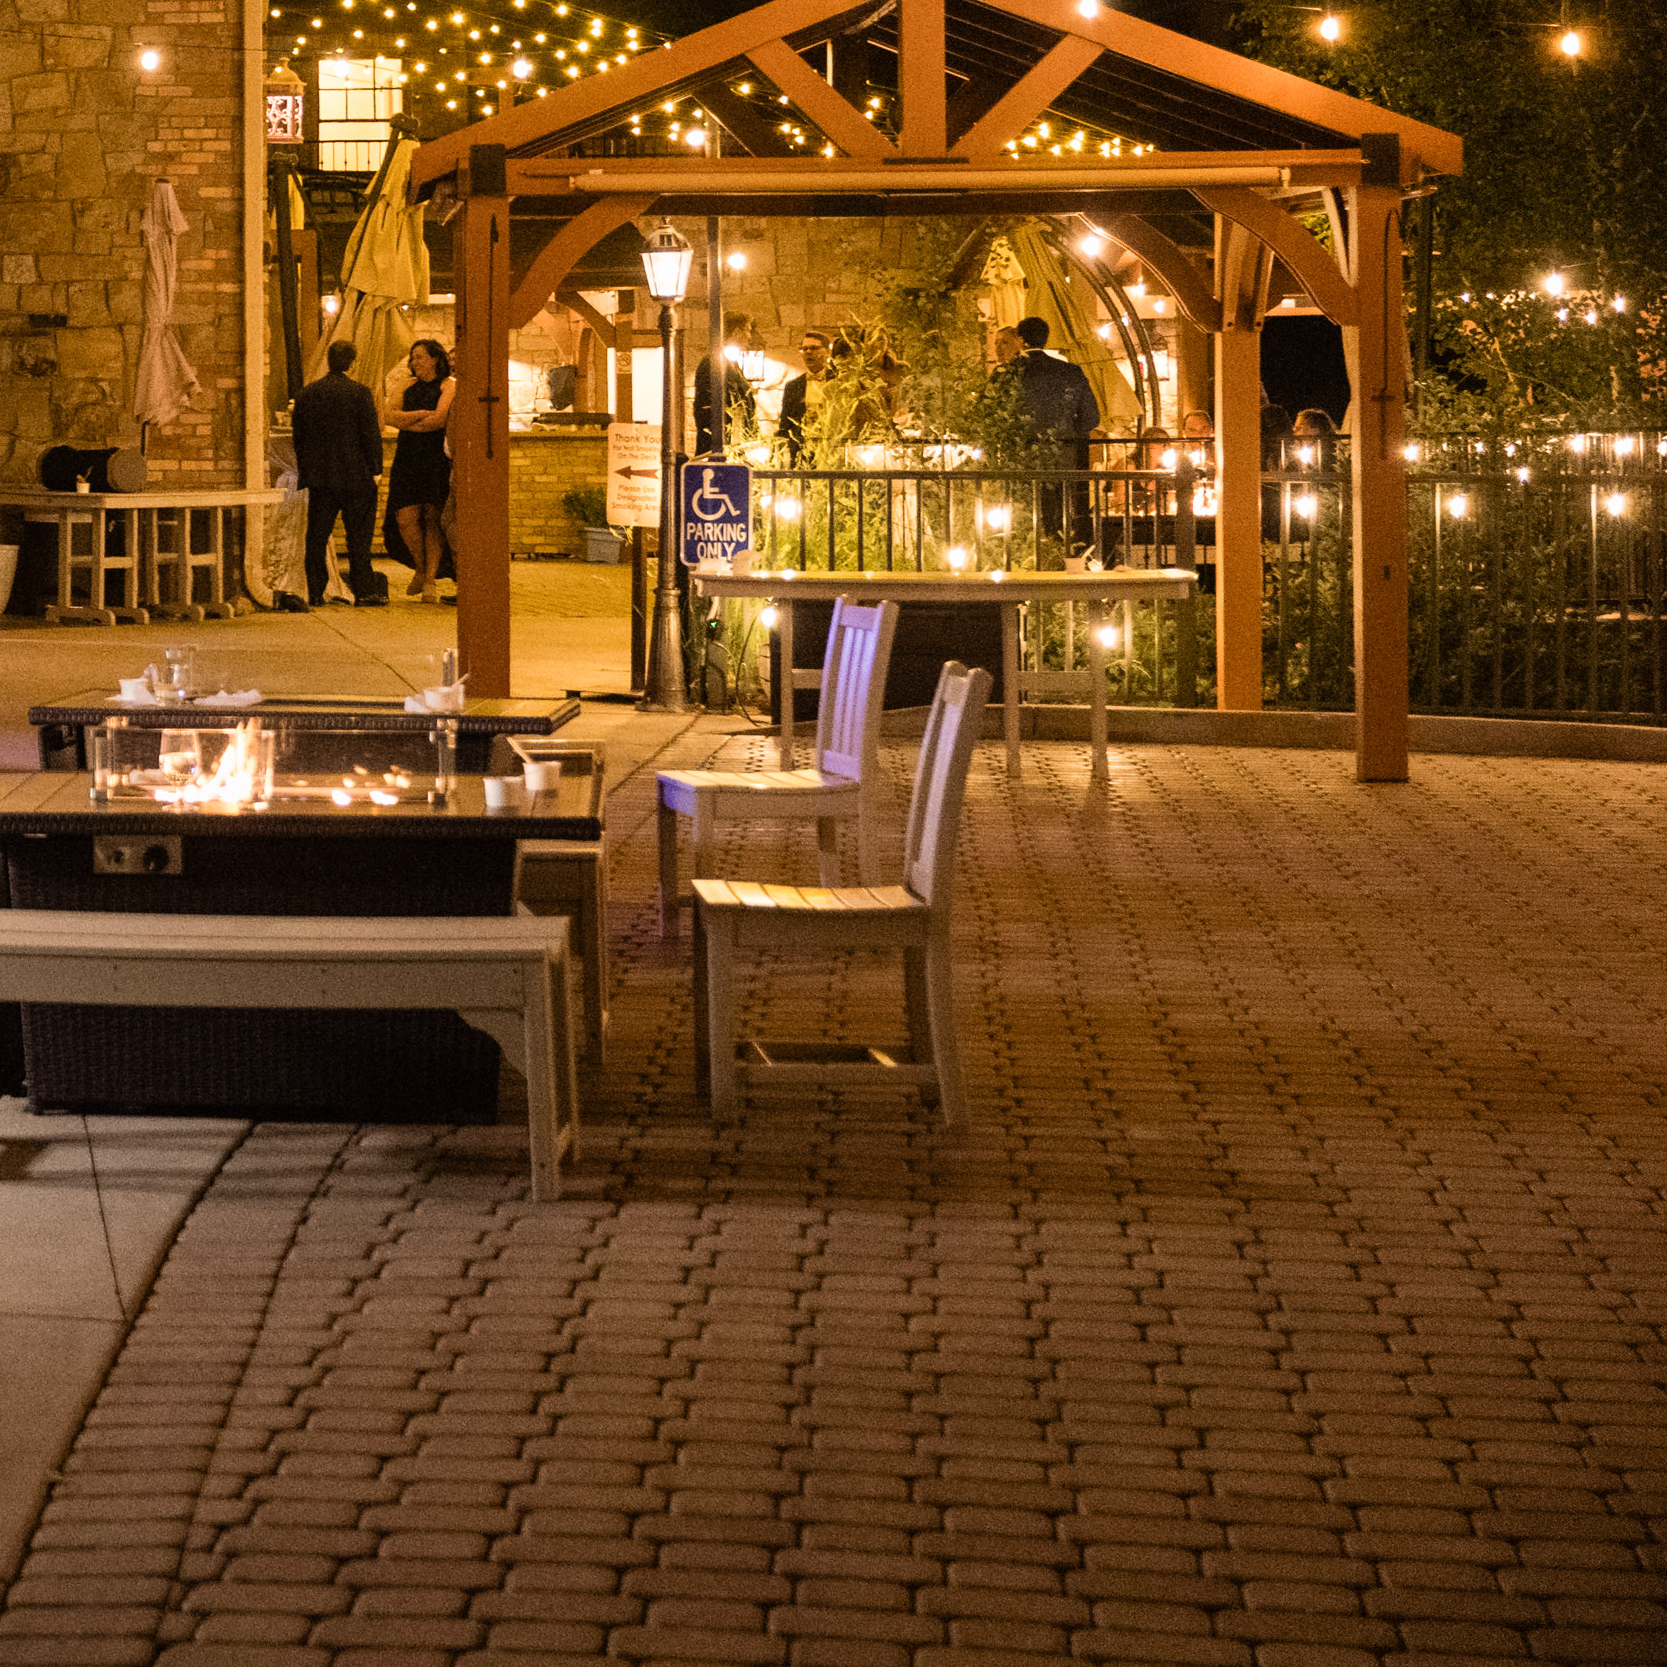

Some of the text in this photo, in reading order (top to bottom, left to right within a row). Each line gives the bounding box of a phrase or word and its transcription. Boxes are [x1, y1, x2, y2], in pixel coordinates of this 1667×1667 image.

[615, 433, 660, 443] Thank You
[618, 484, 641, 492] Please
[617, 493, 657, 502] Designated
[611, 502, 642, 512] Smoking
[686, 522, 747, 542] PARKING
[696, 542, 736, 561] ONLY
